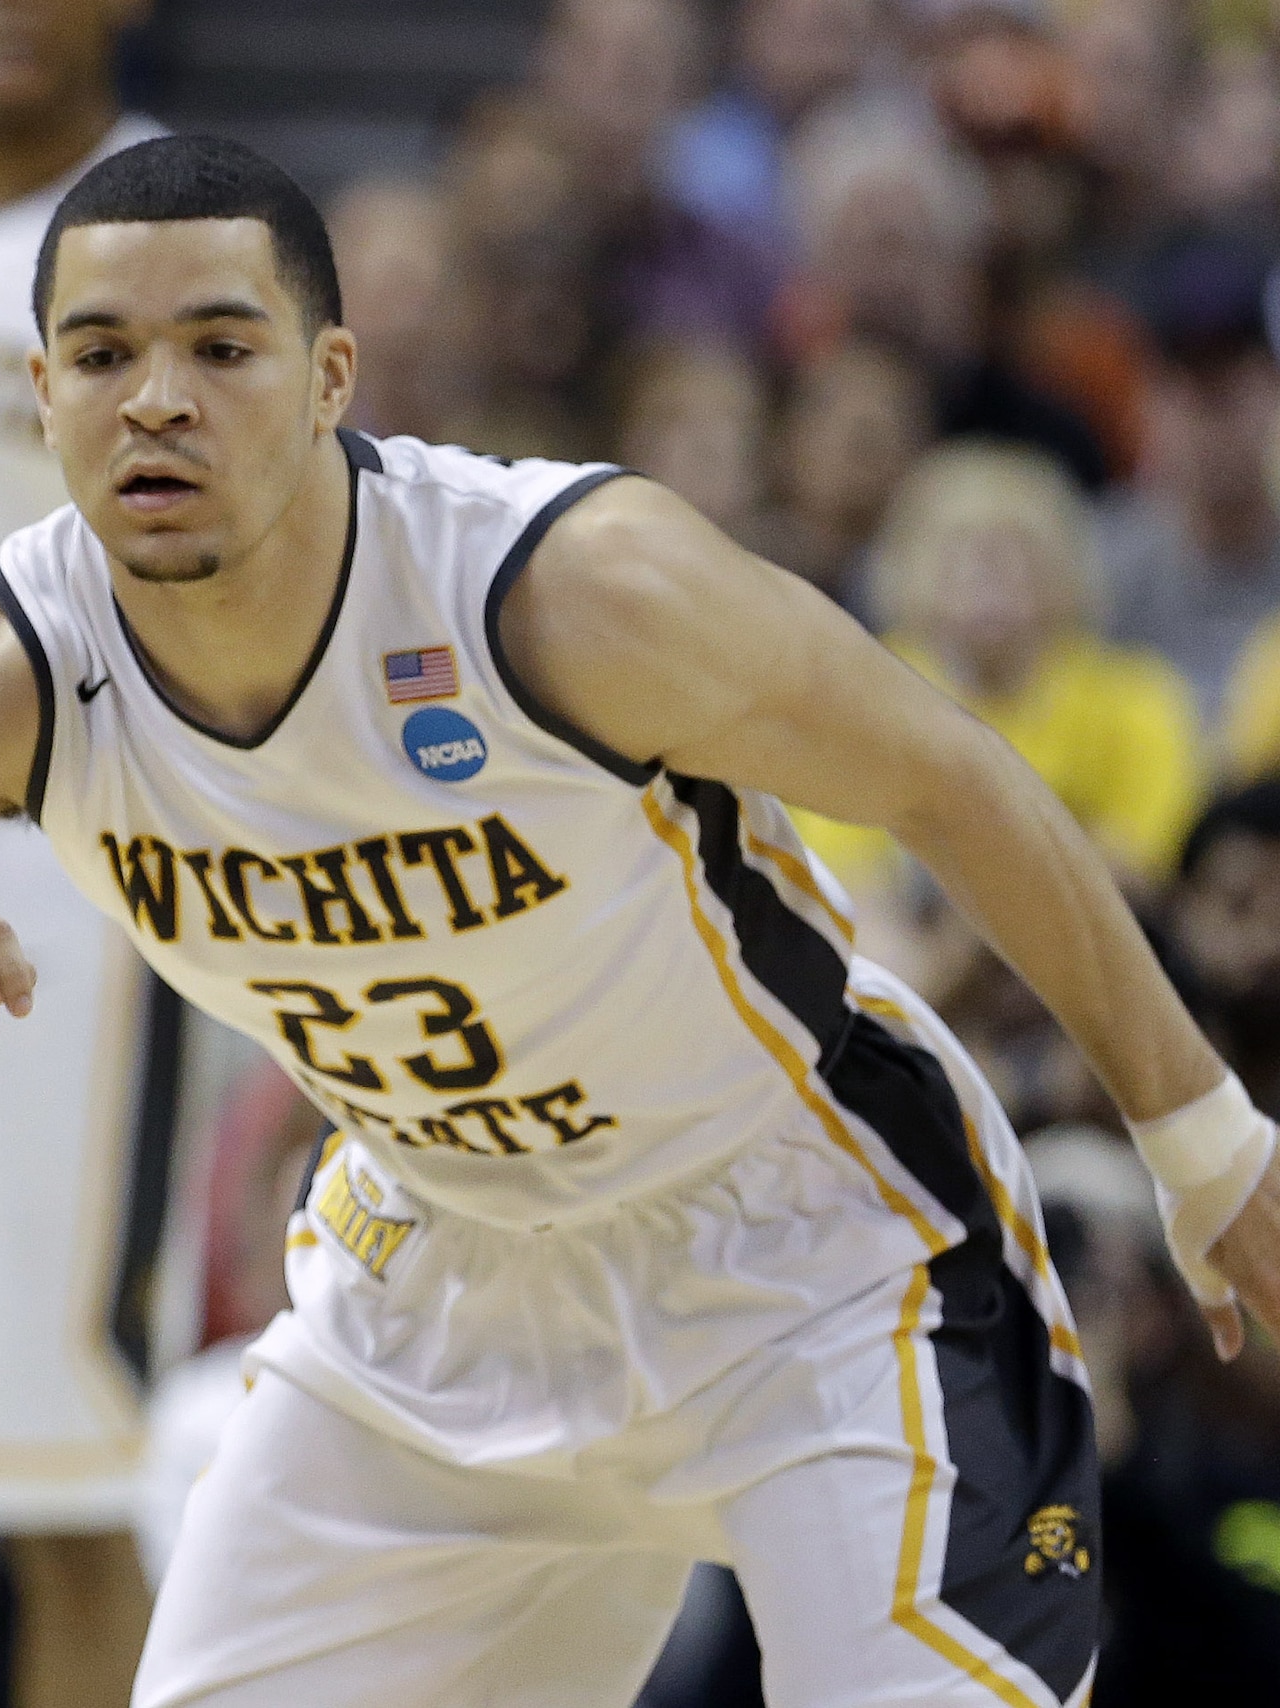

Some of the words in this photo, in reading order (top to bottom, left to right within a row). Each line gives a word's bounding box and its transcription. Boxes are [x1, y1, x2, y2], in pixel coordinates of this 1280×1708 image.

[416, 738, 483, 769] NCAA
[100, 810, 571, 945] WICHITA
[246, 974, 506, 1094] 23
